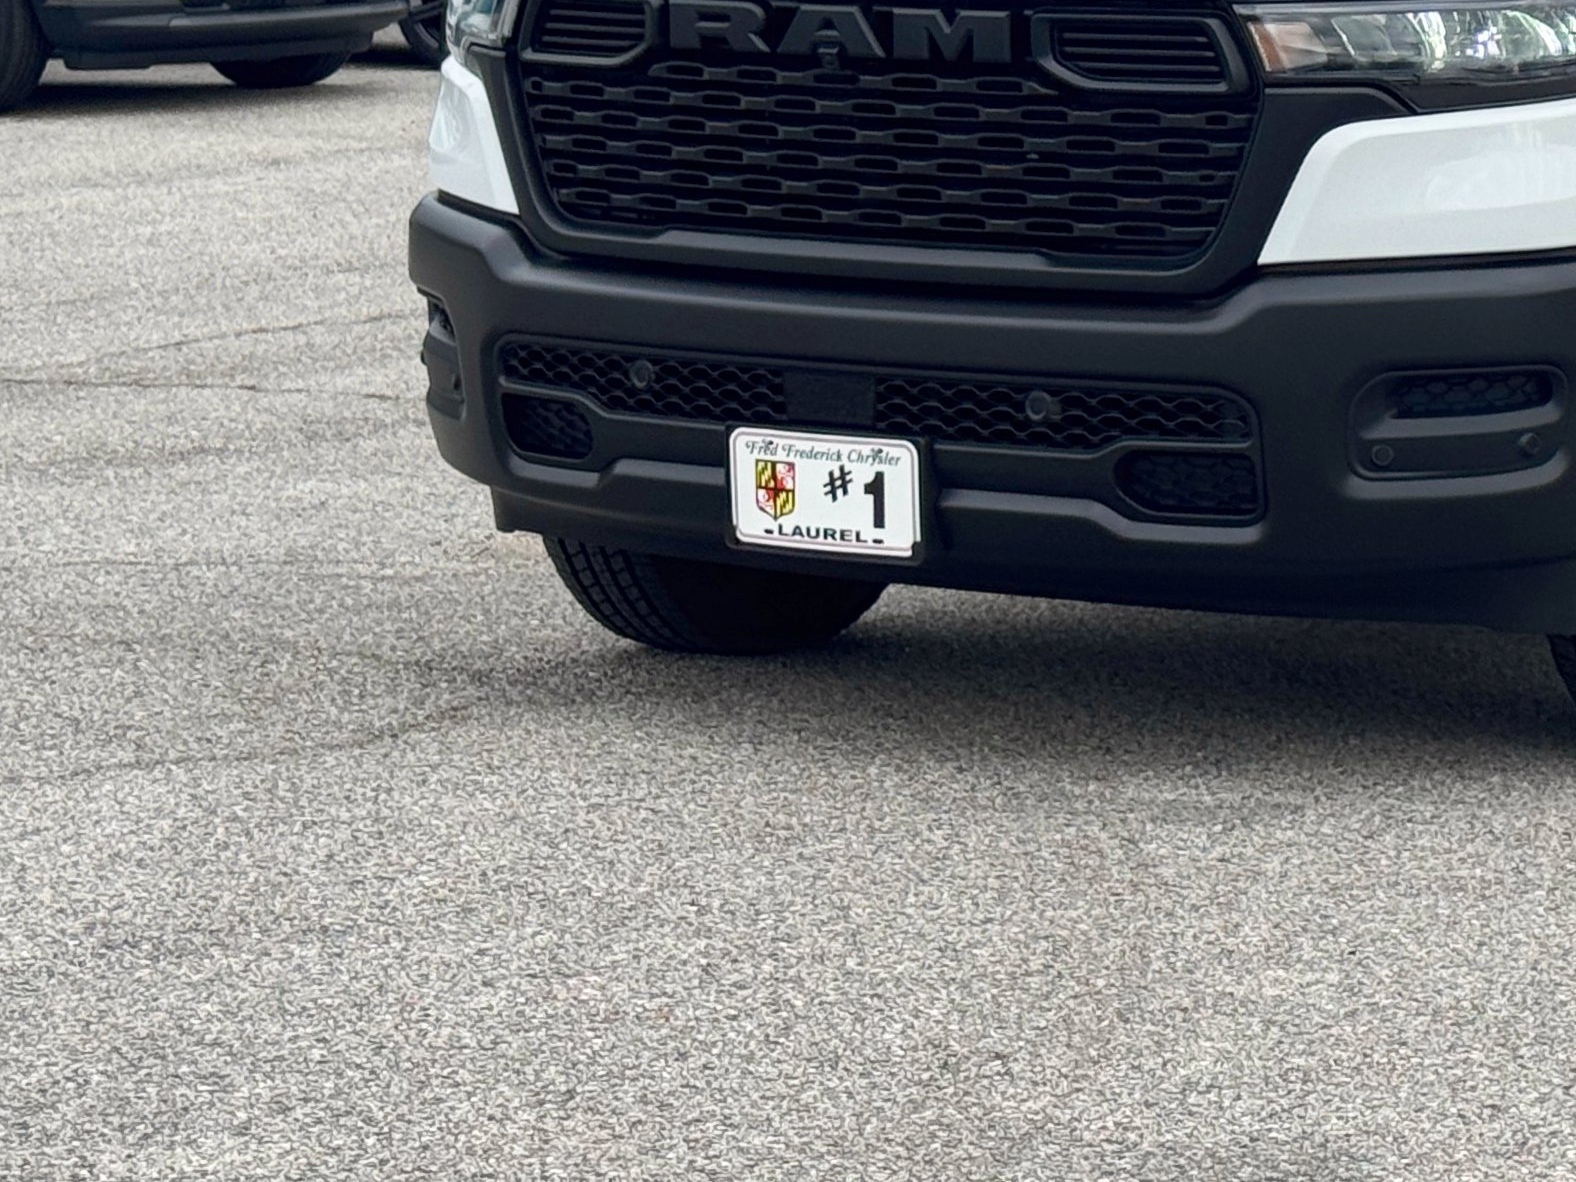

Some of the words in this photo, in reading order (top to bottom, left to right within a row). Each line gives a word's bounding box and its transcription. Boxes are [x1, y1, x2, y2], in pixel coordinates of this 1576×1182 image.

[745, 439, 779, 456] Fred
[782, 443, 843, 462] Frederick
[847, 449, 901, 466] Chrysler
[778, 524, 868, 544] LAUREL
